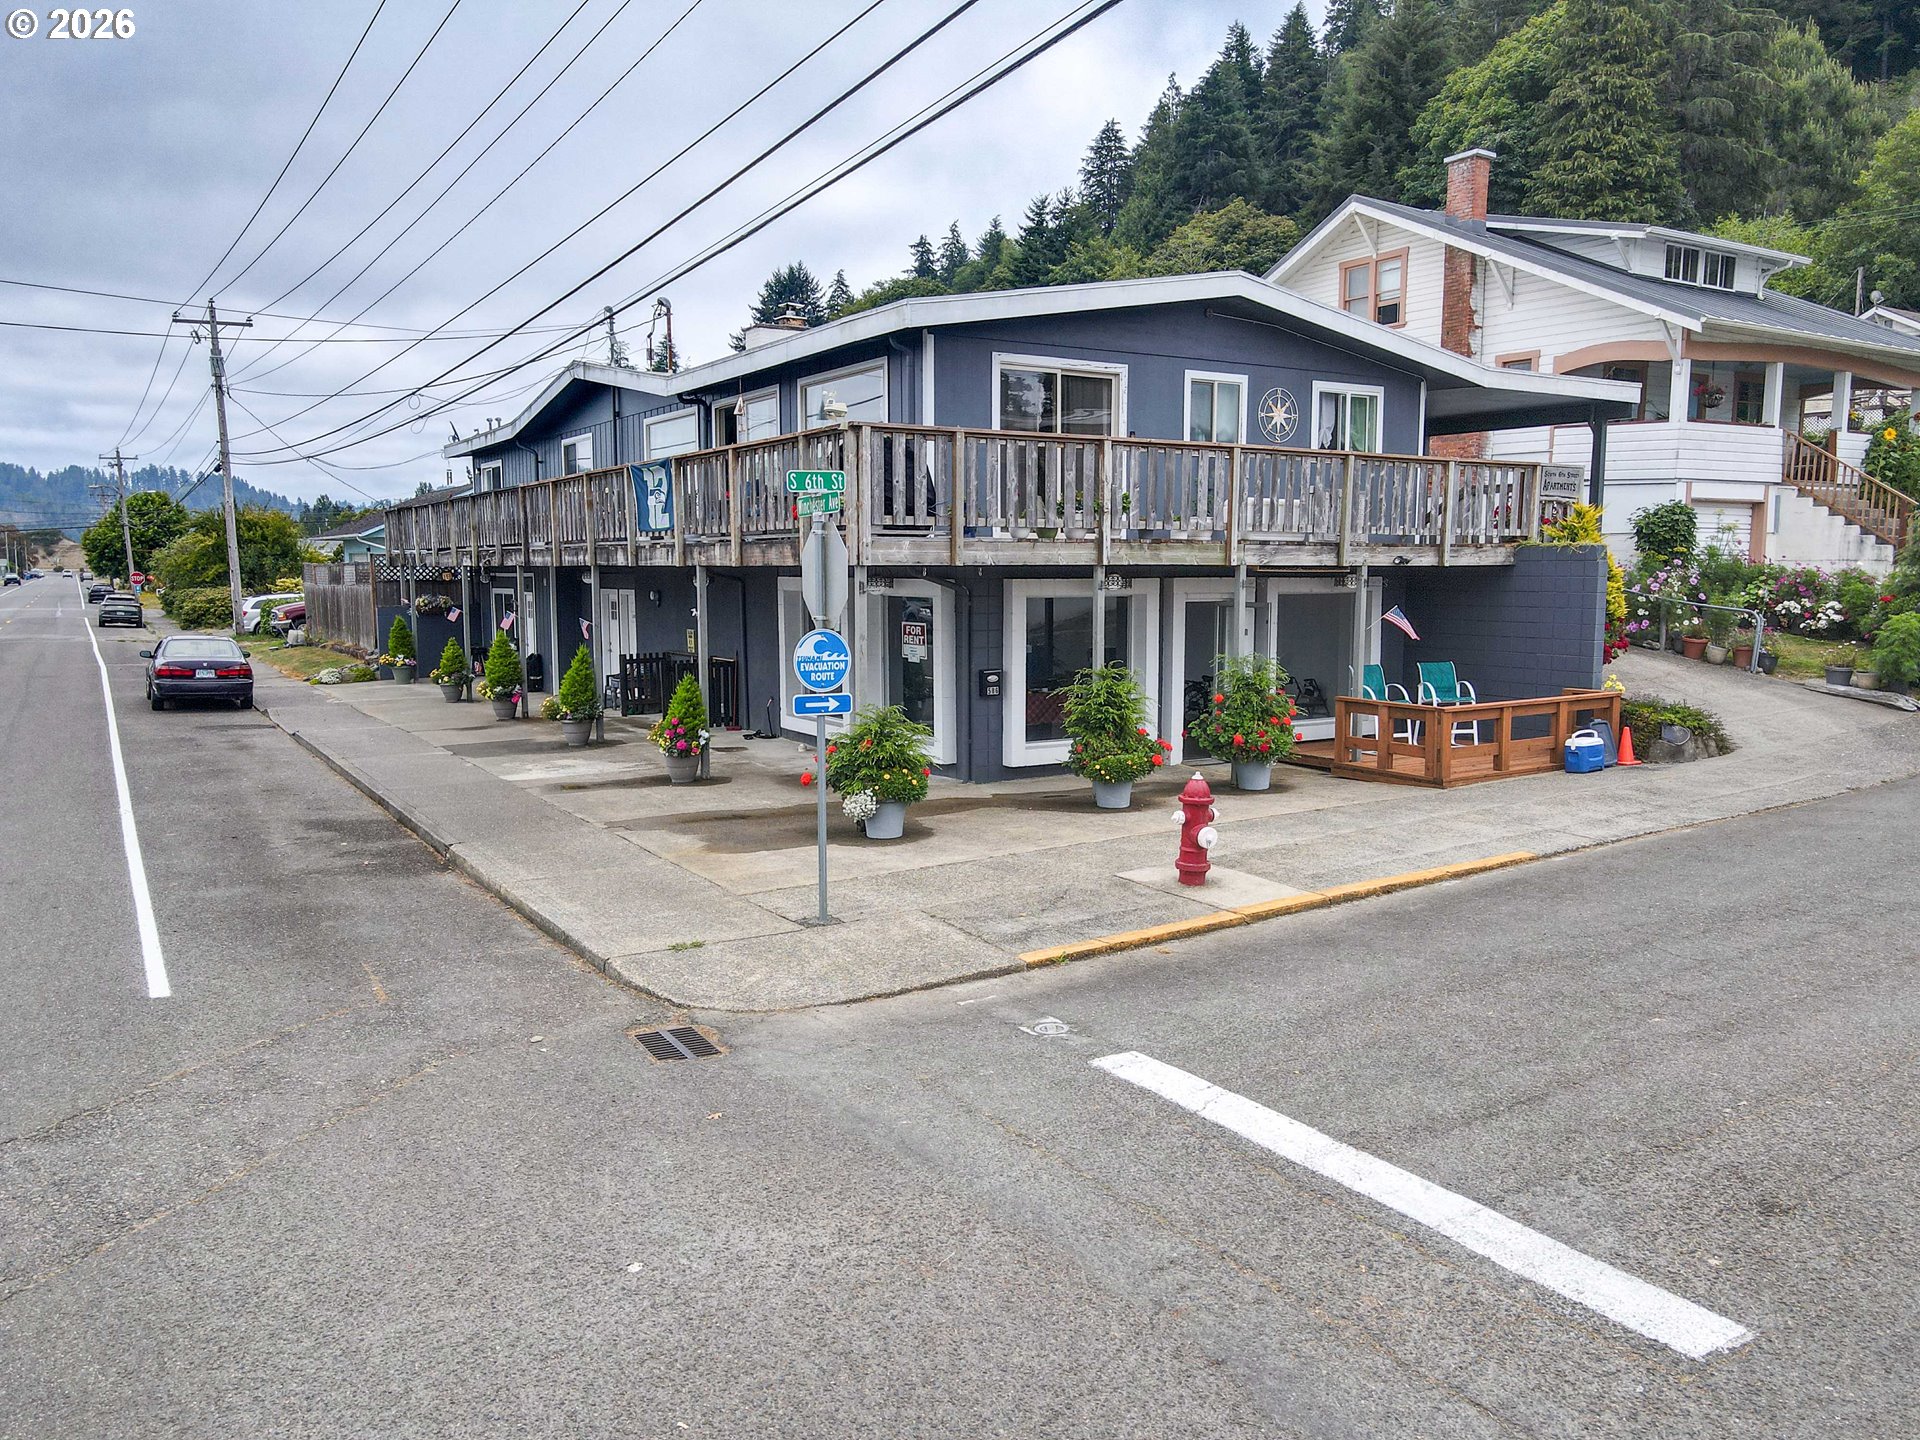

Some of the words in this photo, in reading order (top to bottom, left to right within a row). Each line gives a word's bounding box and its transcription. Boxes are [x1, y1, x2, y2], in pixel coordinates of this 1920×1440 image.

[790, 473, 797, 489] S
[805, 473, 824, 489] 6th
[831, 473, 843, 489] St
[1543, 479, 1577, 492] APARTMENTS
[828, 494, 839, 511] Ave
[905, 625, 922, 635] FOR
[903, 635, 925, 645] RENT
[800, 661, 845, 671] EVACUATION
[810, 672, 835, 681] ROUTE
